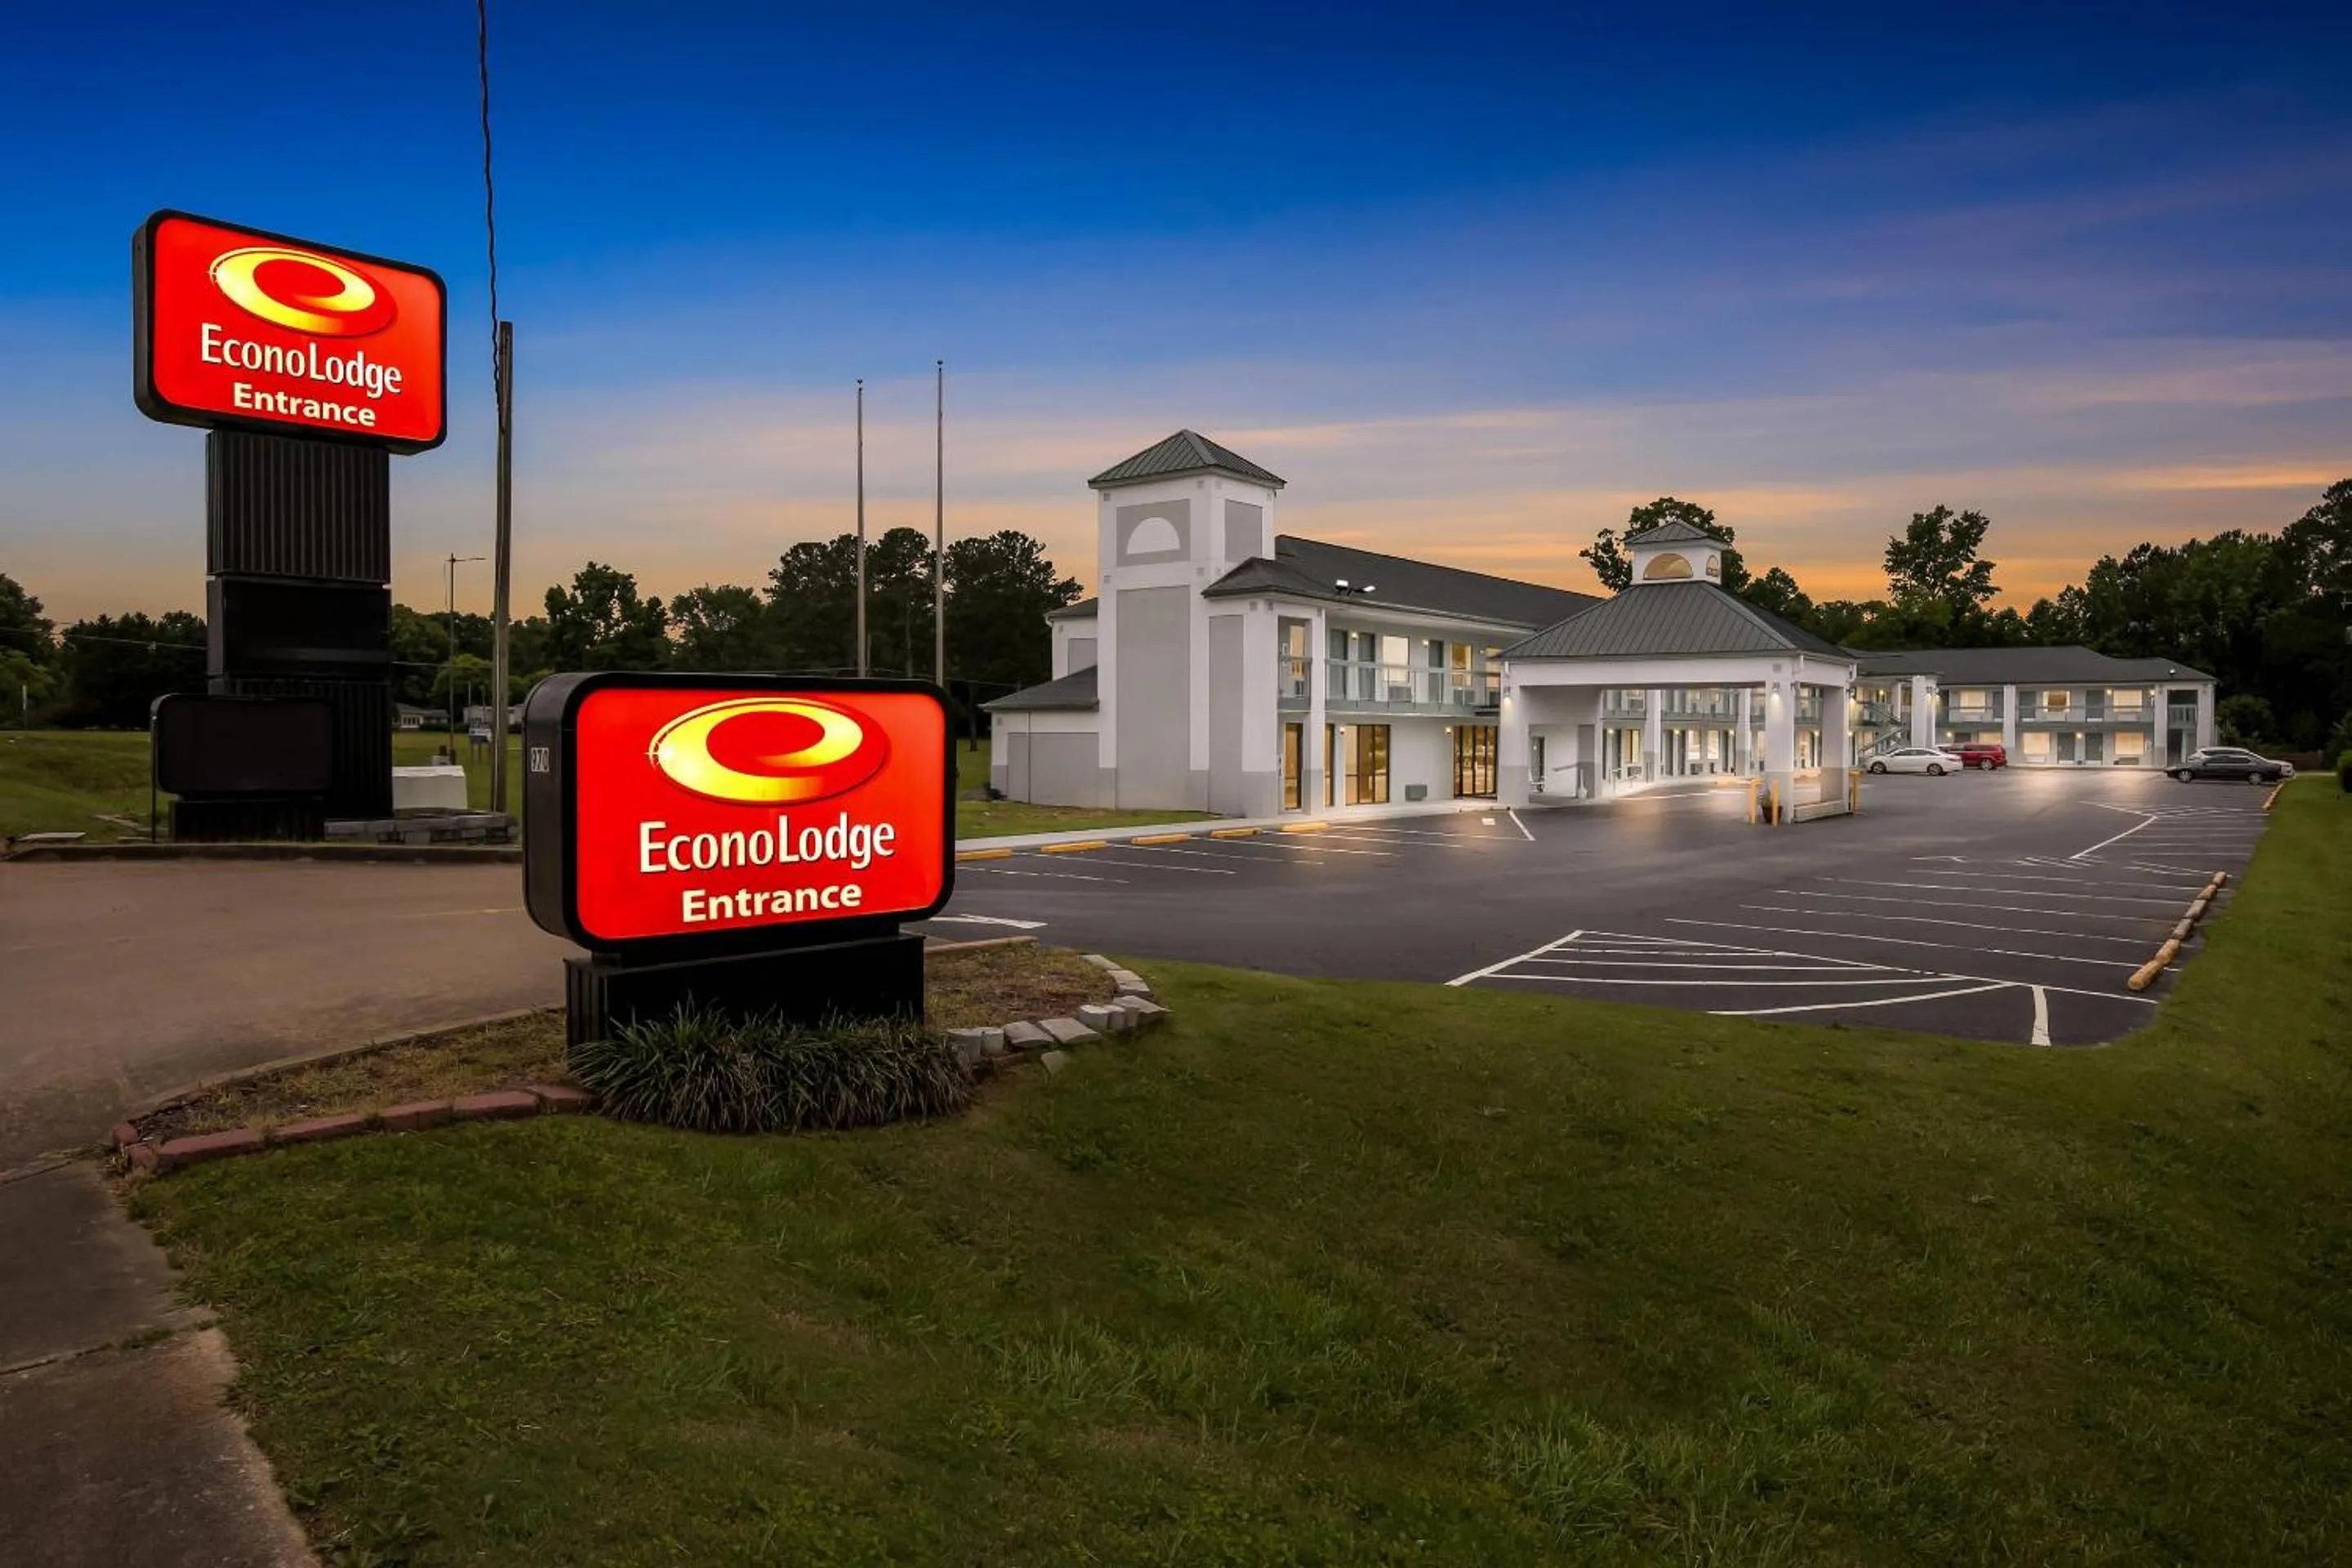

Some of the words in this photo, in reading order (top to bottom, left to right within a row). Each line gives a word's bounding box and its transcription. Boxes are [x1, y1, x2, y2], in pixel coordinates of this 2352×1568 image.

[202, 323, 403, 399] EconoLodge
[234, 382, 376, 427] Entrance
[639, 812, 895, 873] EconoLodge
[682, 883, 862, 923] Entrance
